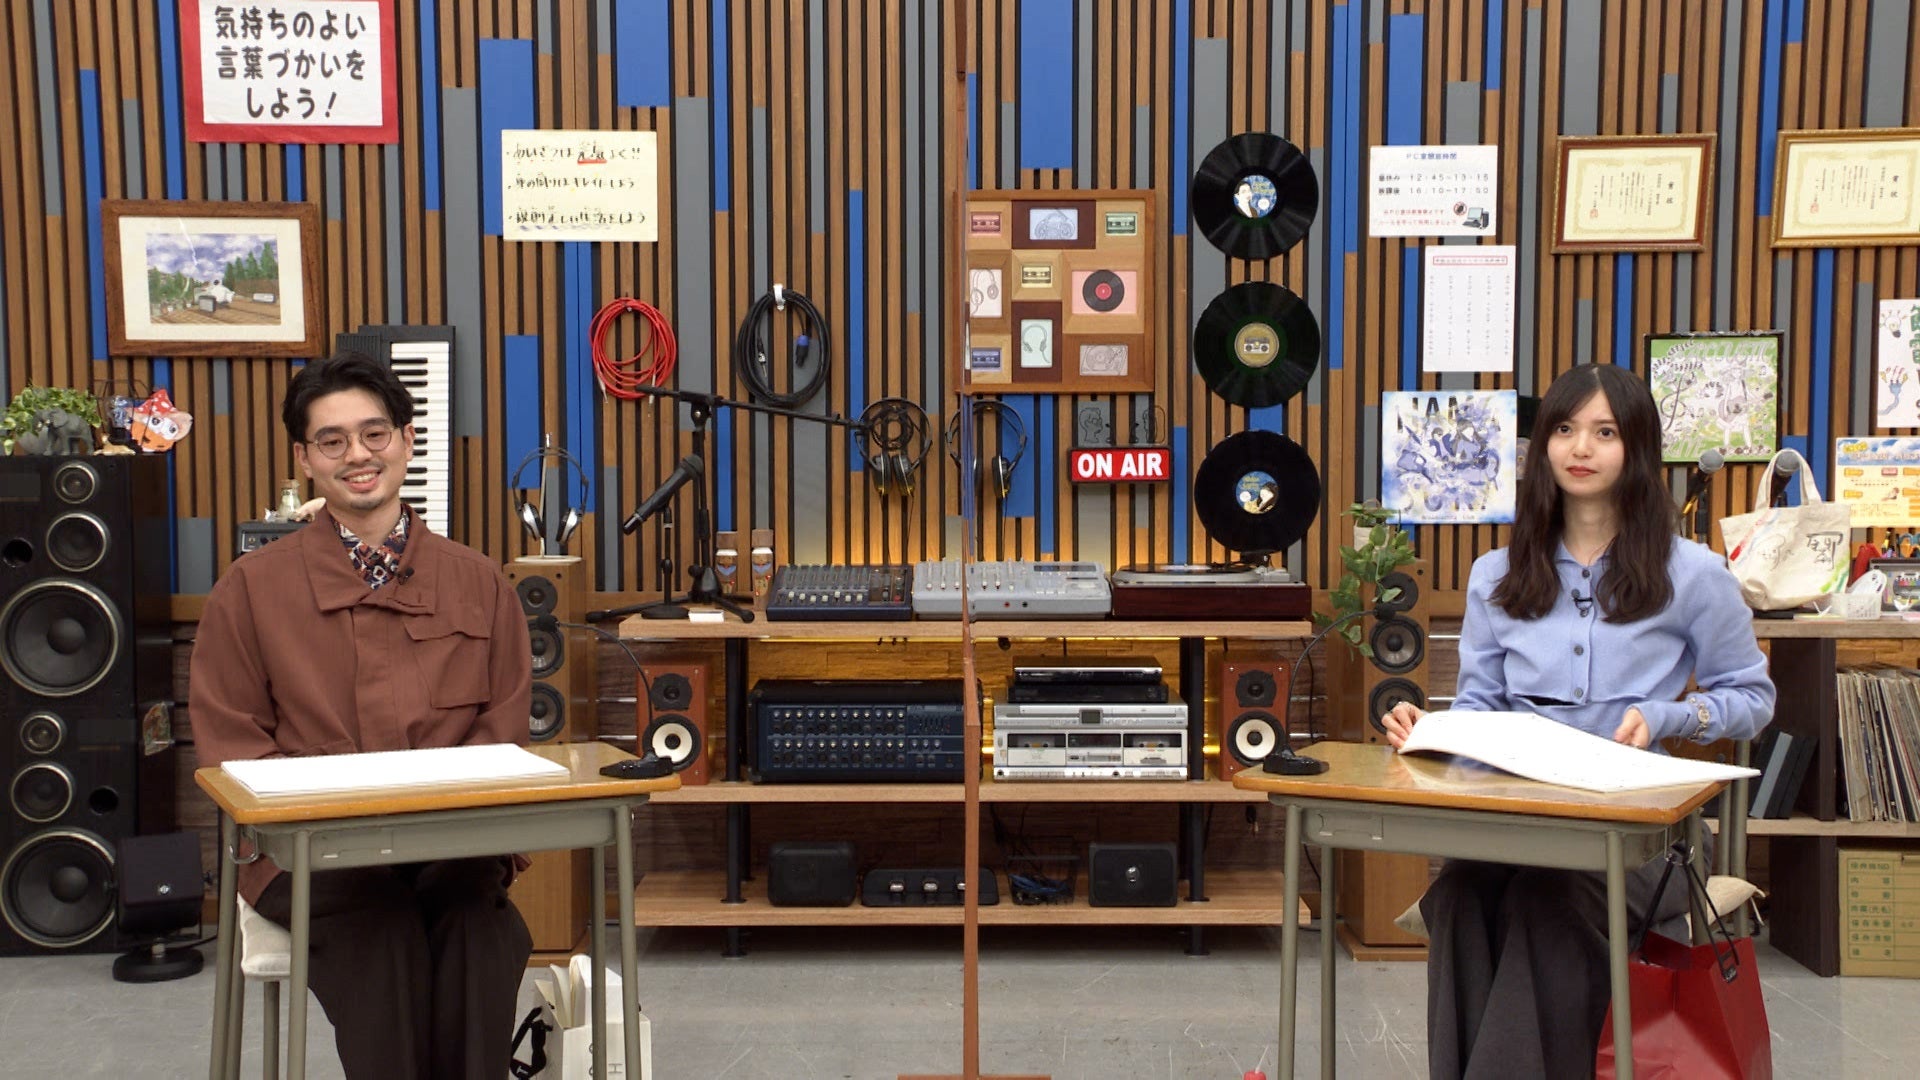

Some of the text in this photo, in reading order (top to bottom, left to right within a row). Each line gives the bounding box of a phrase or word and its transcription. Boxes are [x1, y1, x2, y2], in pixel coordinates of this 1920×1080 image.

[214, 6, 366, 40] 気持ちのよい
[215, 46, 366, 80] 言葉づかいを
[246, 87, 337, 119] しよう!
[1077, 453, 1163, 478] ON AIR
